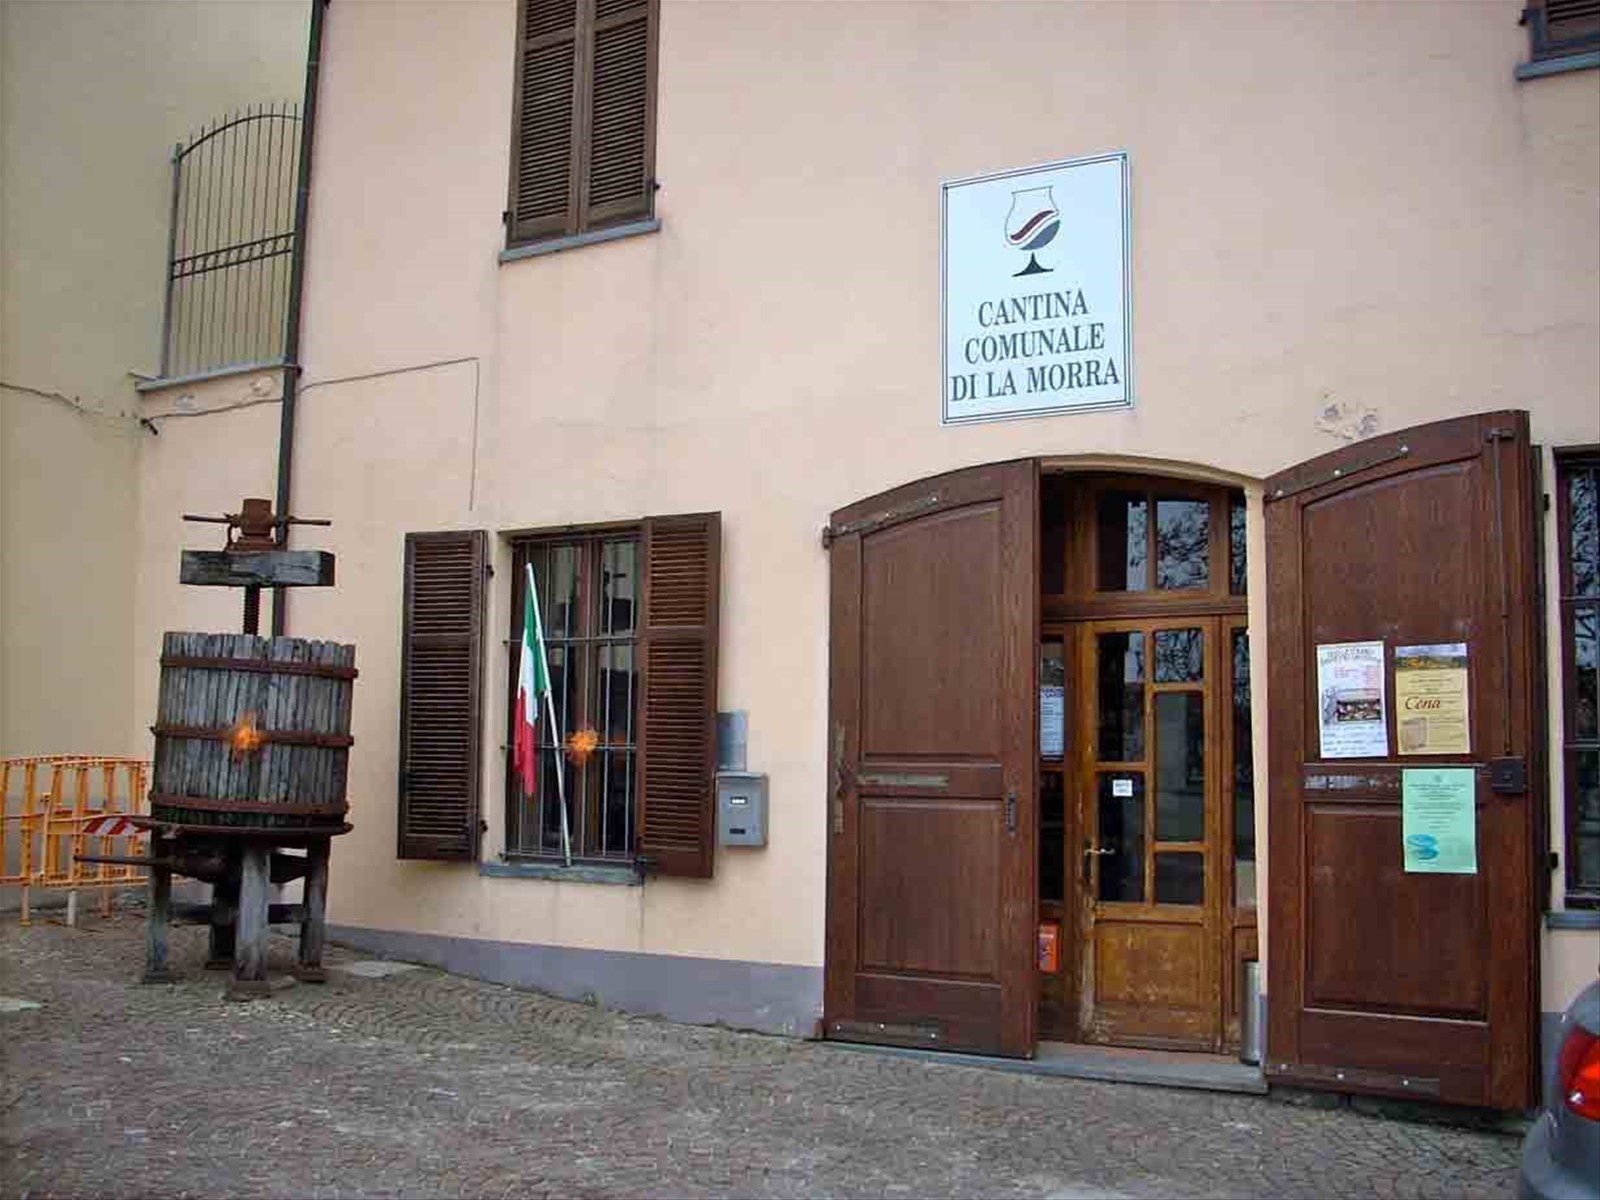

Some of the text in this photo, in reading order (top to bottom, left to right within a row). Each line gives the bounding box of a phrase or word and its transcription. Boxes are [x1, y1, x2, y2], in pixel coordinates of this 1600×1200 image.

[978, 288, 1089, 328] CANTINA
[964, 322, 1105, 364] COMUNALE
[951, 357, 1120, 401] DI LA MORRA
[1405, 695, 1441, 710] Cena
